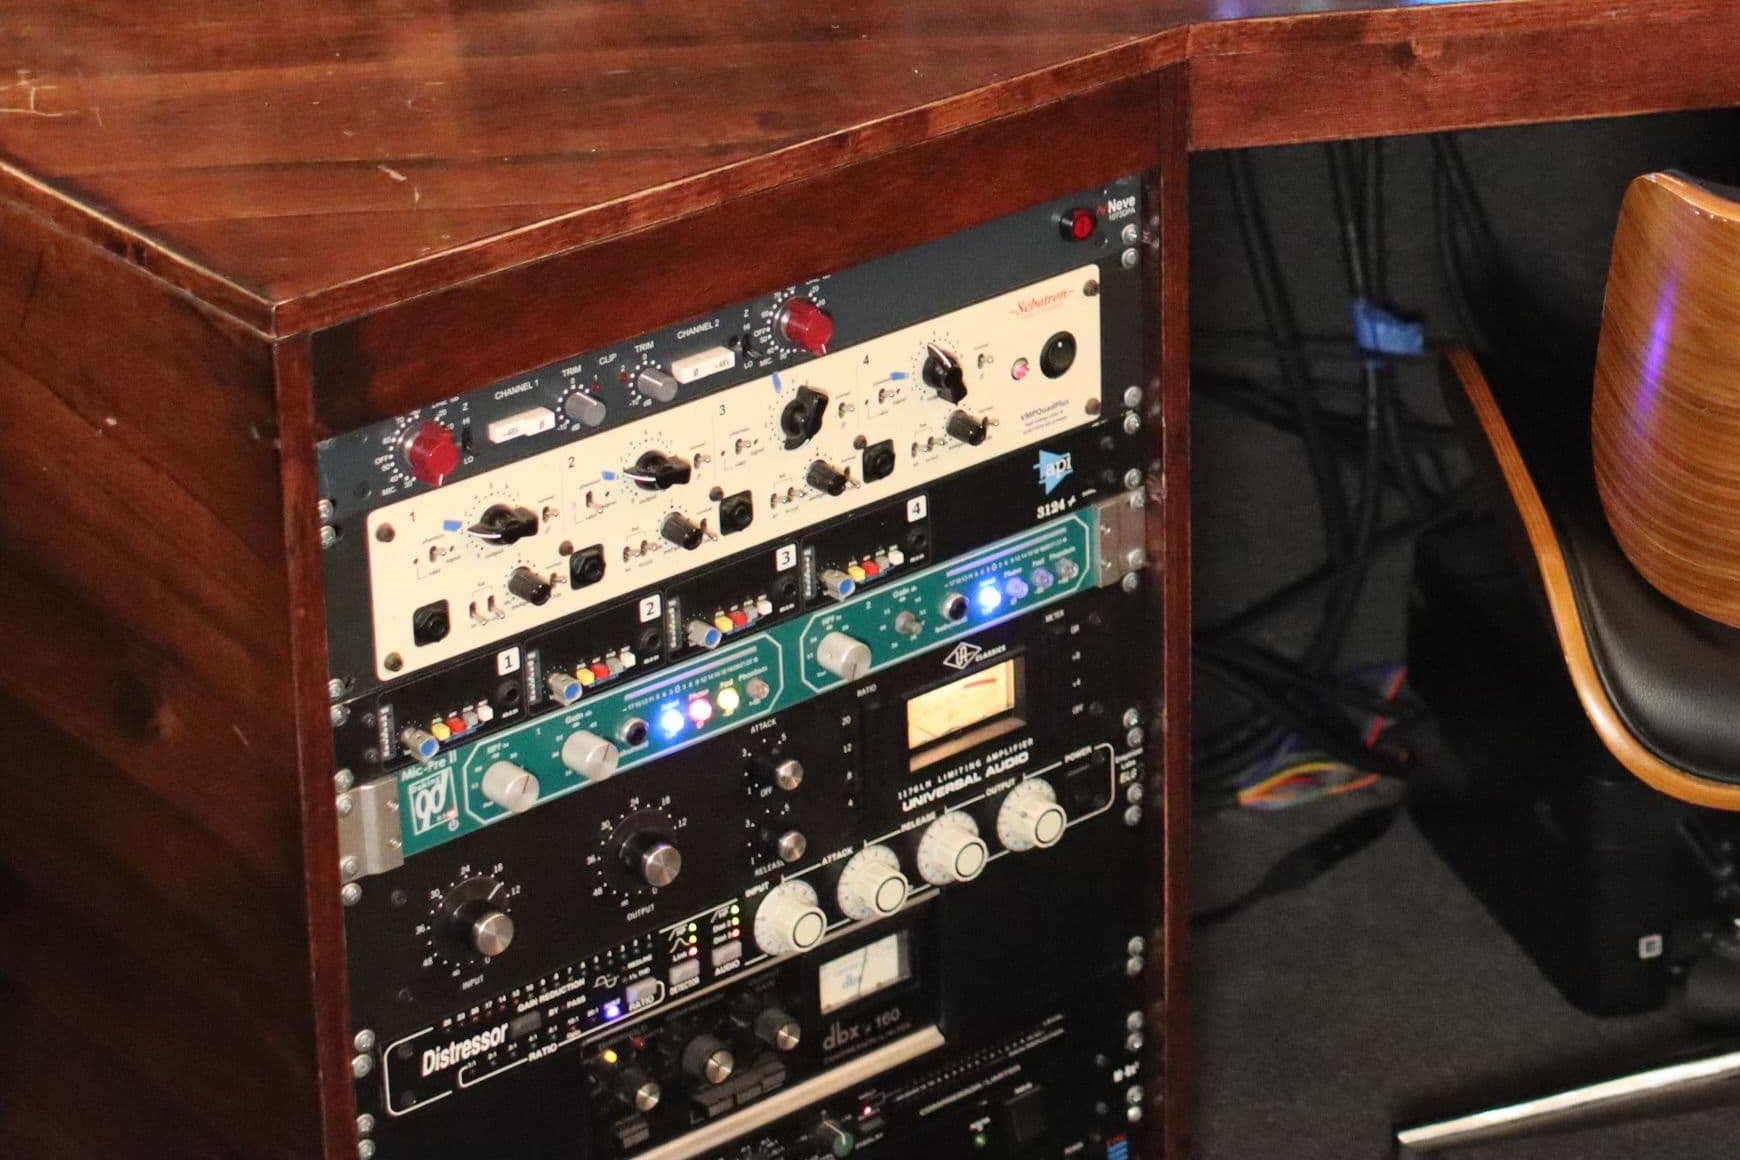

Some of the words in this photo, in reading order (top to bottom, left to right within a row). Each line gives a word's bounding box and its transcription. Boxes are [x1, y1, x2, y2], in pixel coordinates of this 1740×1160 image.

[1107, 195, 1136, 213] Neve
[677, 322, 715, 340] CHANNEL
[714, 318, 720, 329] 2
[634, 340, 655, 354] TRIM
[599, 352, 617, 366] CLIP
[863, 354, 870, 366] 4
[562, 364, 583, 378] TRIM
[494, 383, 533, 400] CHANNEL
[719, 404, 727, 416] 3
[568, 456, 575, 469] 2
[1045, 455, 1072, 479] api
[409, 511, 416, 523] 1
[911, 502, 921, 515] 4
[781, 550, 791, 565] 3
[645, 601, 655, 616] 2
[504, 655, 512, 670] 1
[856, 683, 877, 698] RATIO
[750, 717, 777, 734] ATTACK
[937, 760, 982, 784] LIMITING
[986, 737, 1034, 763] AMPLIFIER
[1064, 745, 1093, 763] POWER
[401, 757, 447, 782] Mic-Pre
[902, 774, 982, 812] UNIVERSAL
[985, 751, 1029, 778] AUDIO
[985, 777, 1016, 797] OUTPUT
[821, 846, 854, 866] ATTACK
[745, 881, 769, 899] INPUT
[626, 903, 655, 921] OUTPUT
[714, 959, 741, 976] AUDIO
[462, 973, 484, 990] INPUT
[517, 997, 538, 1013] GAIN
[538, 977, 586, 1003] REDUCTION
[822, 1020, 860, 1051] dbx
[874, 1008, 901, 1028] 160
[421, 1021, 509, 1078] Distressor
[528, 1042, 558, 1062] RATIO
